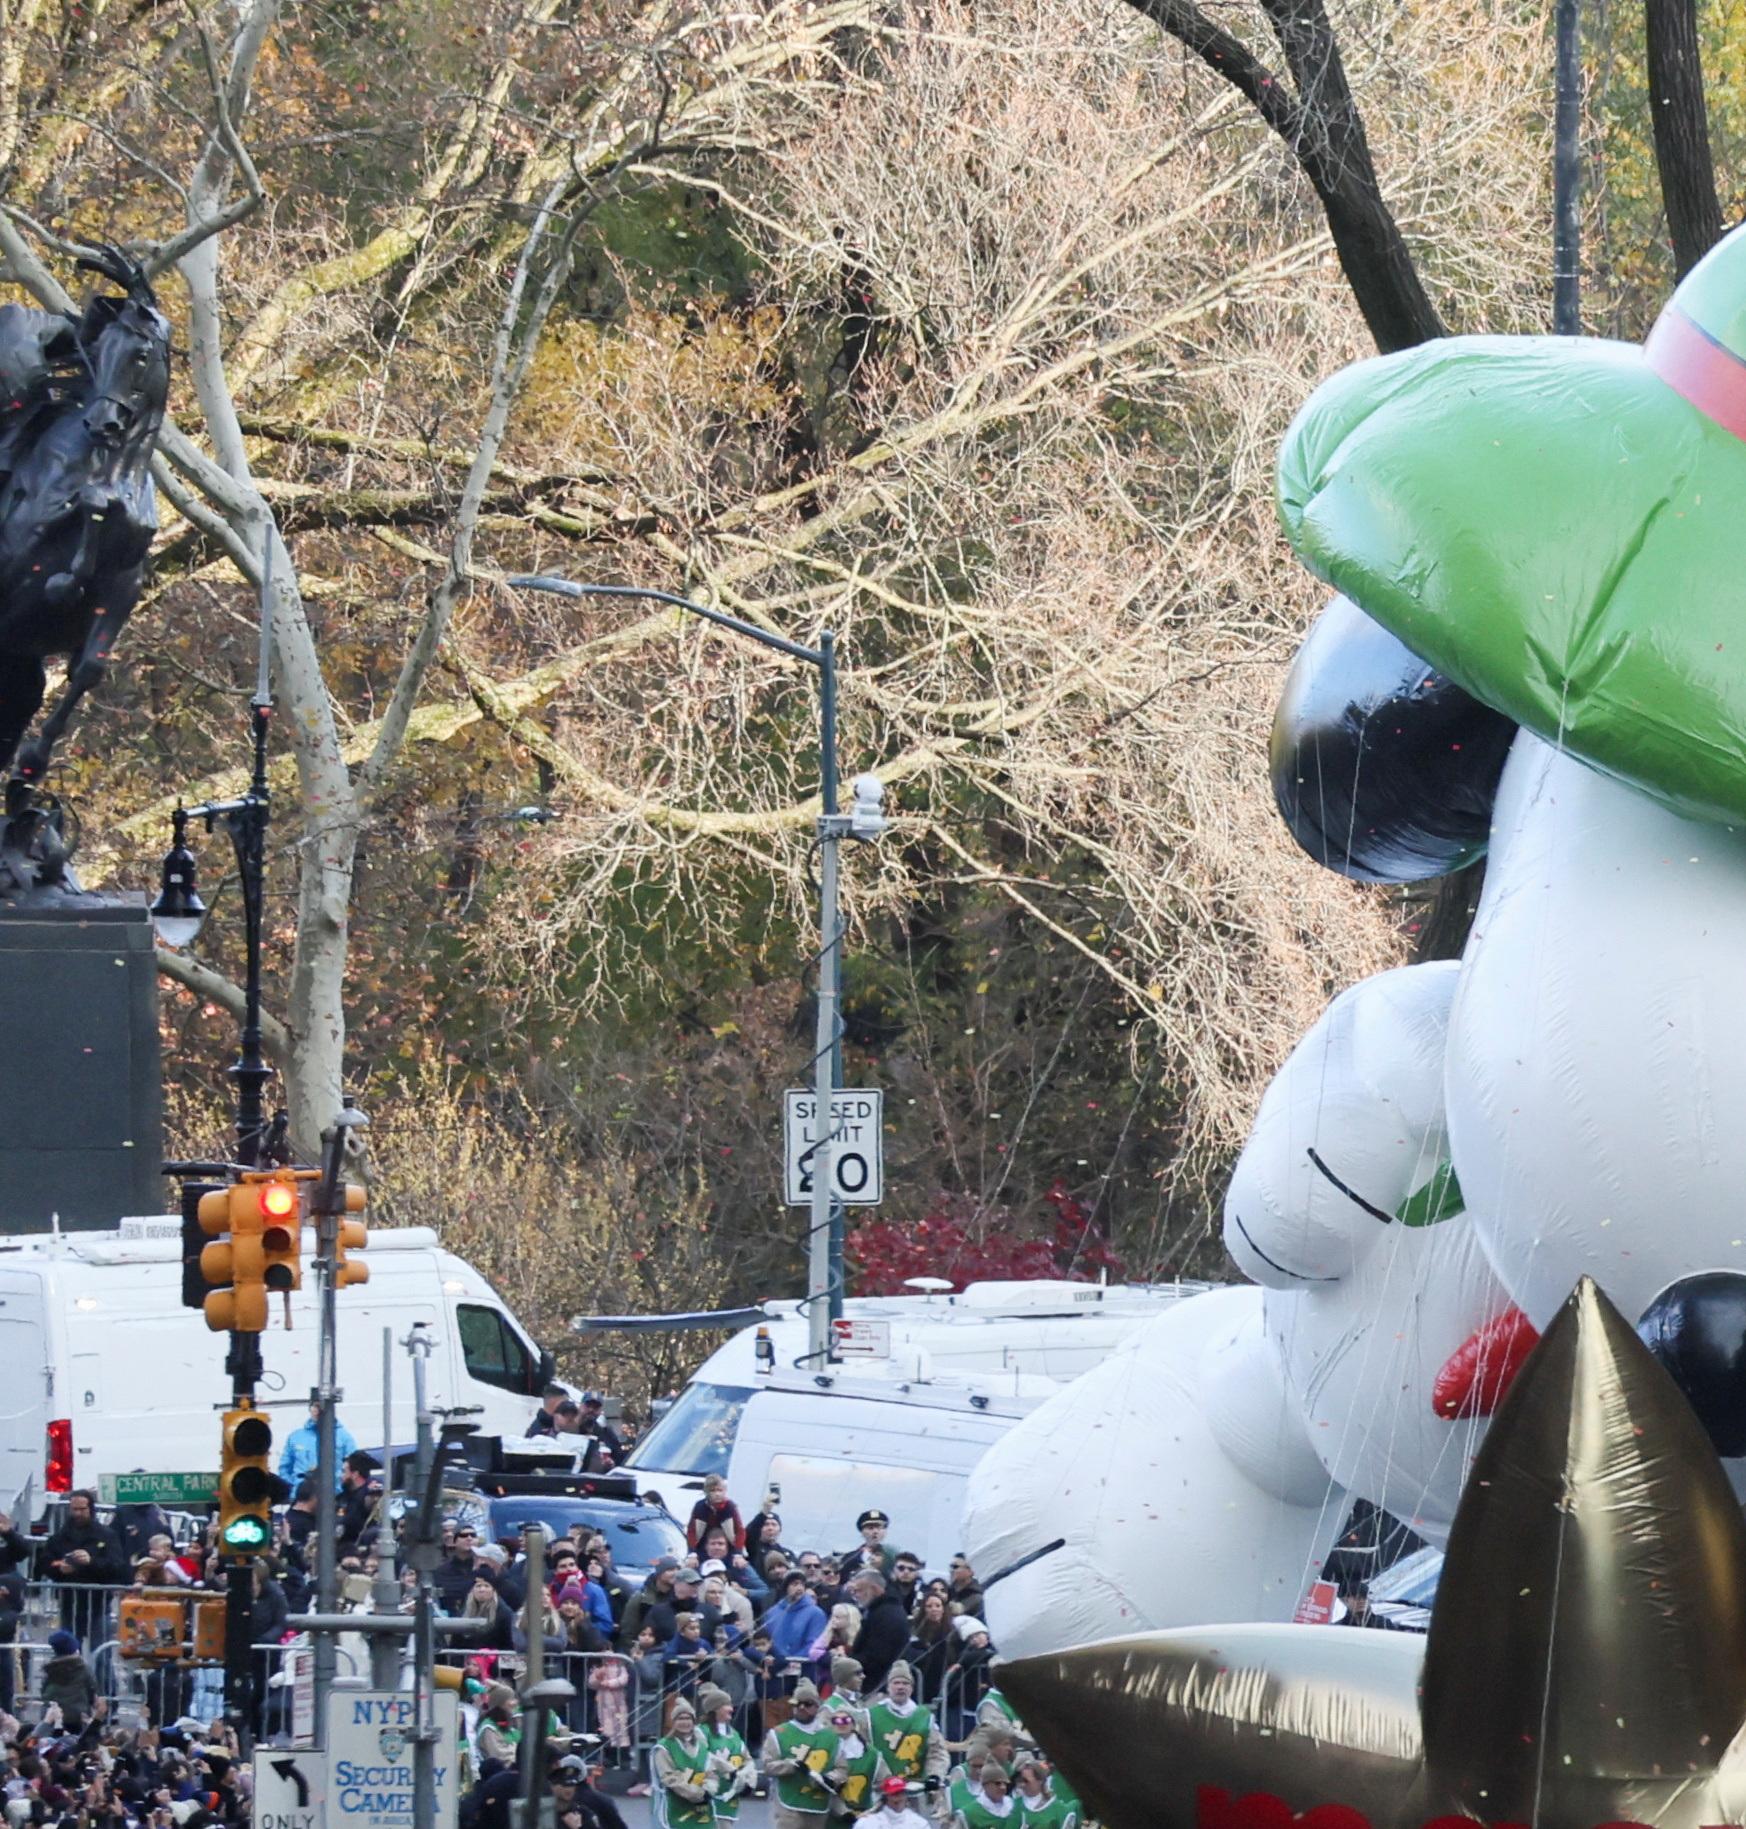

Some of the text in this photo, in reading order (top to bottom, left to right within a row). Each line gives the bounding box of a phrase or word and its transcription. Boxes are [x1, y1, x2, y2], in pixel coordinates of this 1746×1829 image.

[803, 1126, 863, 1143] LMIT
[117, 1477, 178, 1492] CENTRAL
[352, 1701, 416, 1725] NYP
[336, 1762, 447, 1786] SECURY
[340, 1789, 441, 1813] CAME
